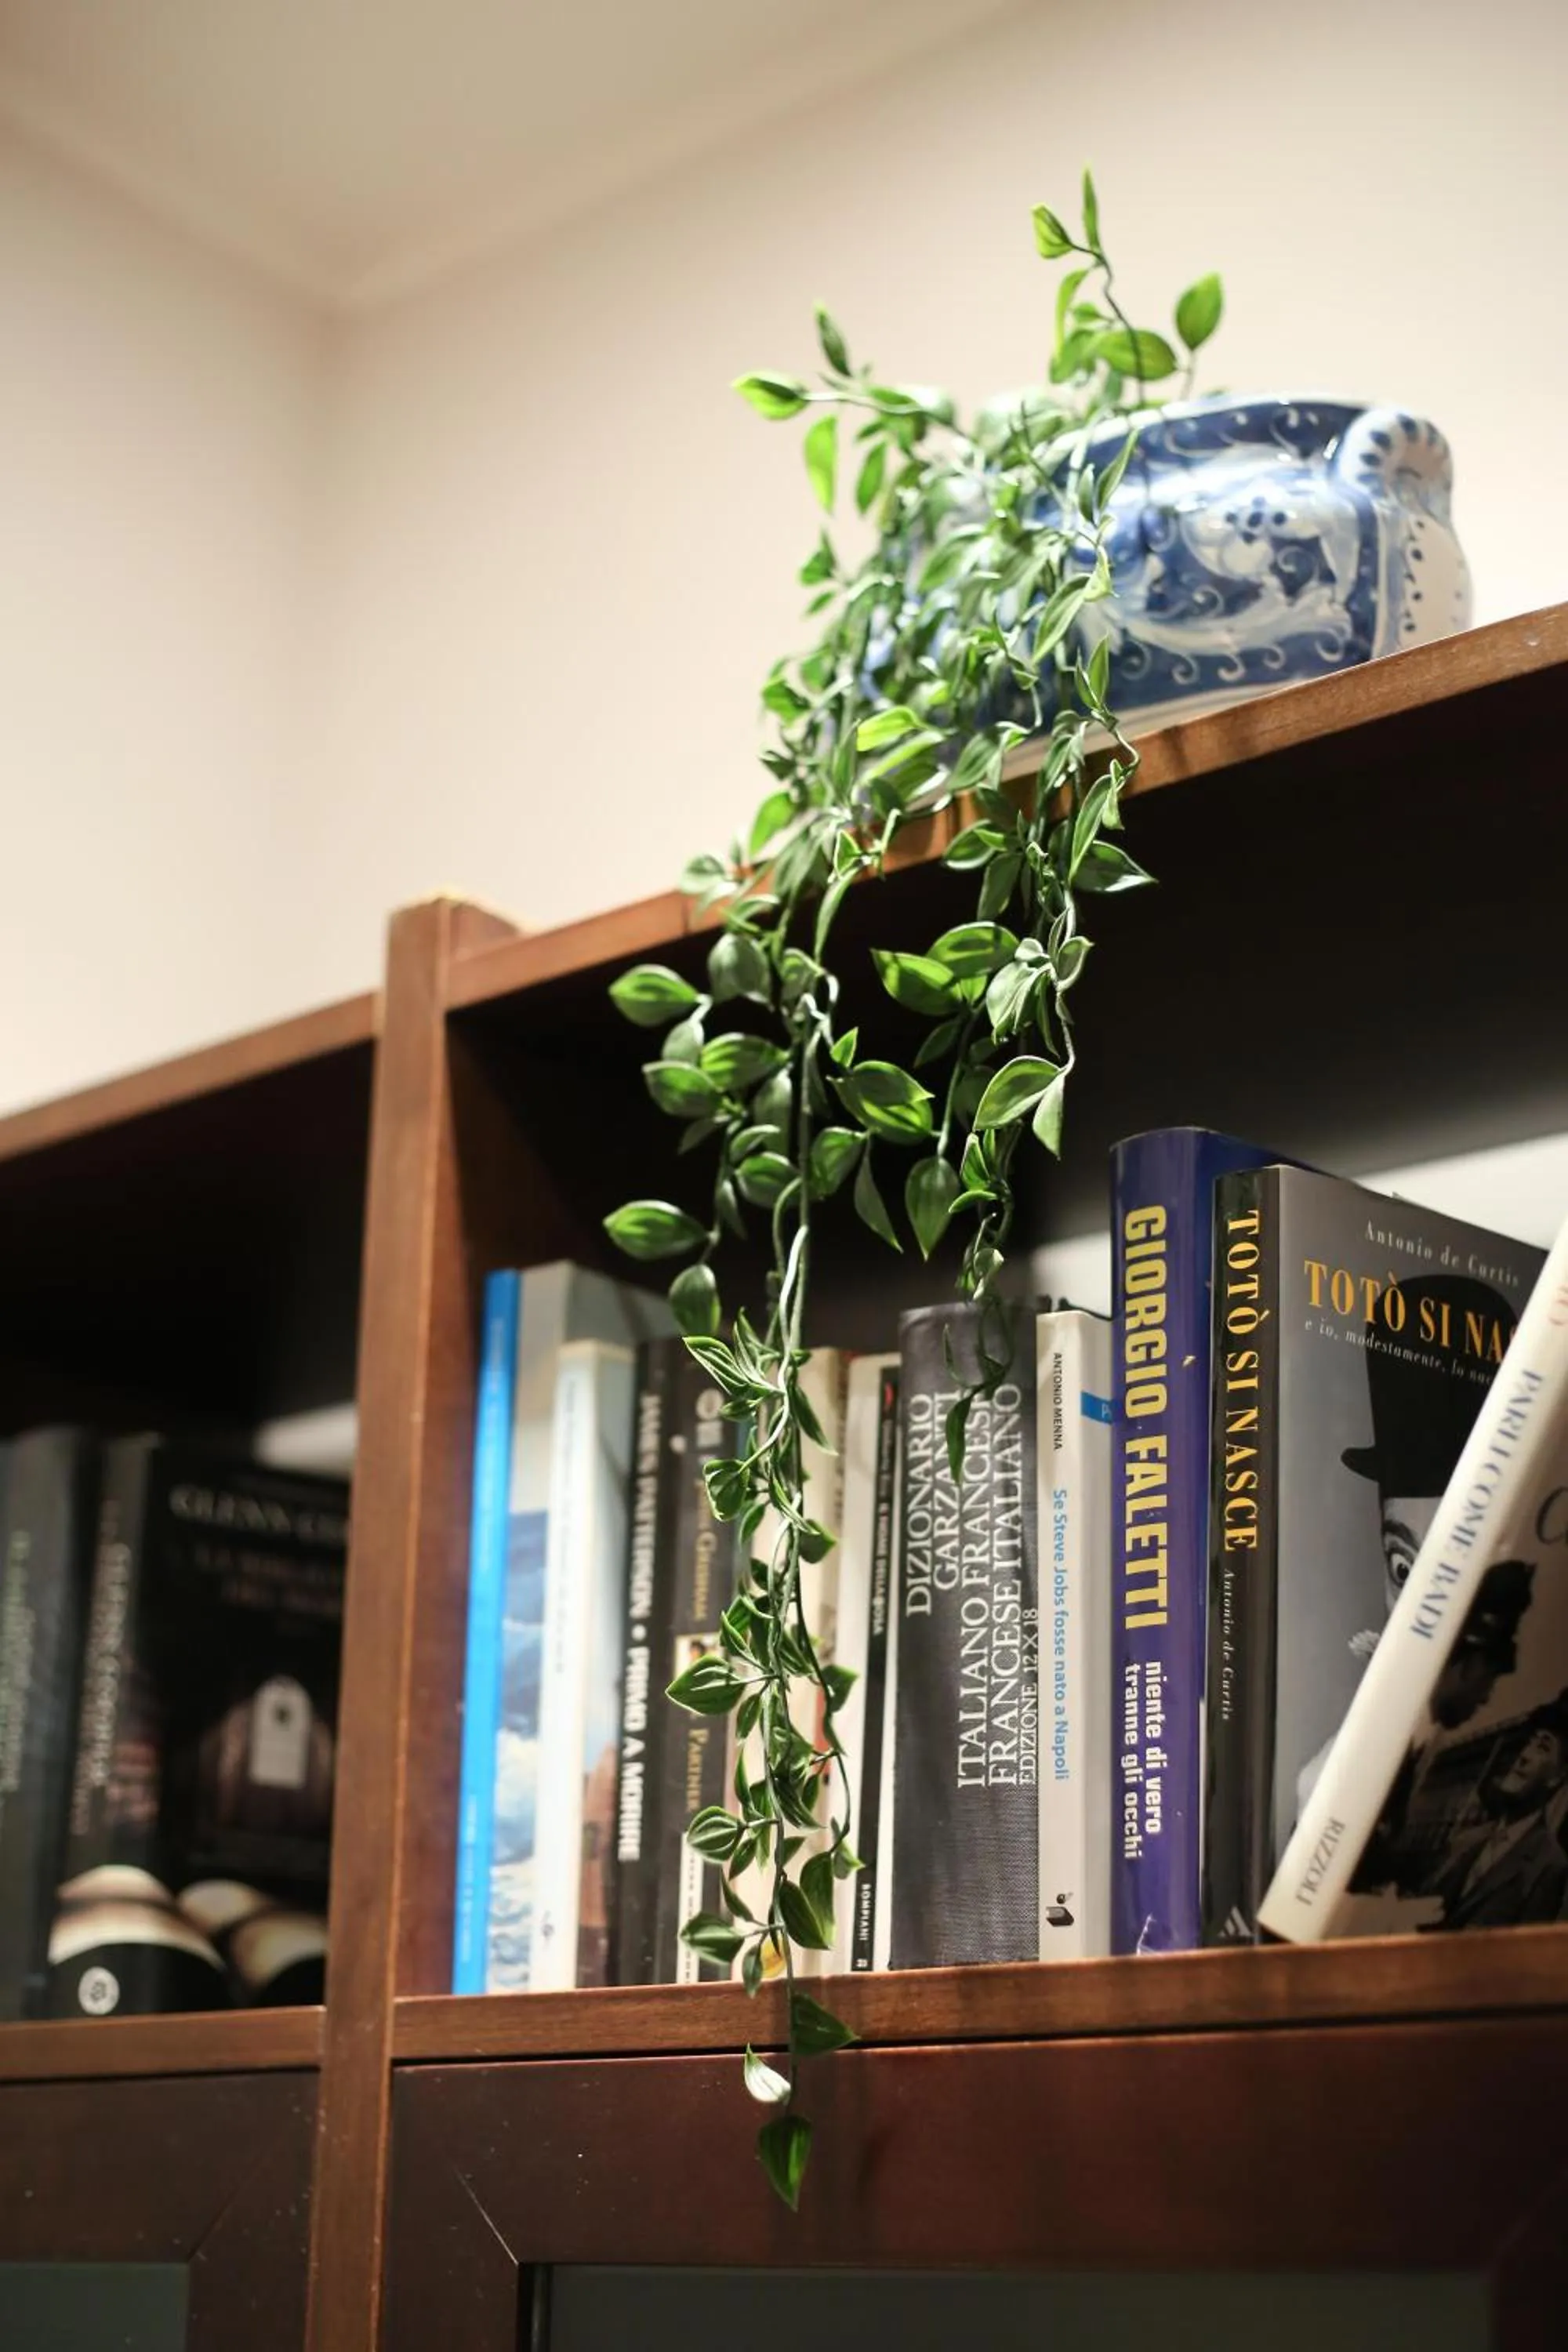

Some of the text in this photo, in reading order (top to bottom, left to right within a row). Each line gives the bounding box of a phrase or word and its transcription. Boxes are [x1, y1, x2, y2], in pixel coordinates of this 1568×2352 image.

[1303, 1259, 1406, 1332] TOTÒ
[1419, 1295, 1451, 1348] SI
[1364, 1219, 1519, 1288] Antonio de Curtis
[1224, 1210, 1270, 1552] TOTÒ SI NASCE
[1305, 1319, 1313, 1332] e
[1319, 1318, 1339, 1340] io,
[1345, 1330, 1446, 1374] modestamente,
[1052, 1352, 1063, 1450] ANTONIO MENNA
[1125, 1205, 1167, 1628] GIORGIO FALETTI
[906, 1393, 934, 1617] DIZIONARIO
[1450, 1462, 1502, 1556] COME
[618, 1394, 661, 1861] JAMES PATTERSON PRIMO A MORIRE
[989, 1383, 1022, 1786] FRANCESE ITALIANO
[1022, 1607, 1038, 1626] 18
[1410, 1563, 1461, 1641] BADI
[1023, 1653, 1038, 1672] 12
[1051, 1490, 1069, 1781] Se Steve Jobs fosse nato a Napoli
[1221, 1568, 1236, 1720] Antonio de Curtis
[958, 1597, 989, 1788] ITALIANO
[1021, 1682, 1037, 1784] EDIZIONE
[687, 1729, 710, 1813] PARTNER
[1121, 1663, 1143, 1859] tranne gli occhi
[1145, 1661, 1167, 1835] niente di vero
[858, 1883, 872, 1941] BOMPIANI
[1295, 1817, 1346, 1907] RIZZOLI
